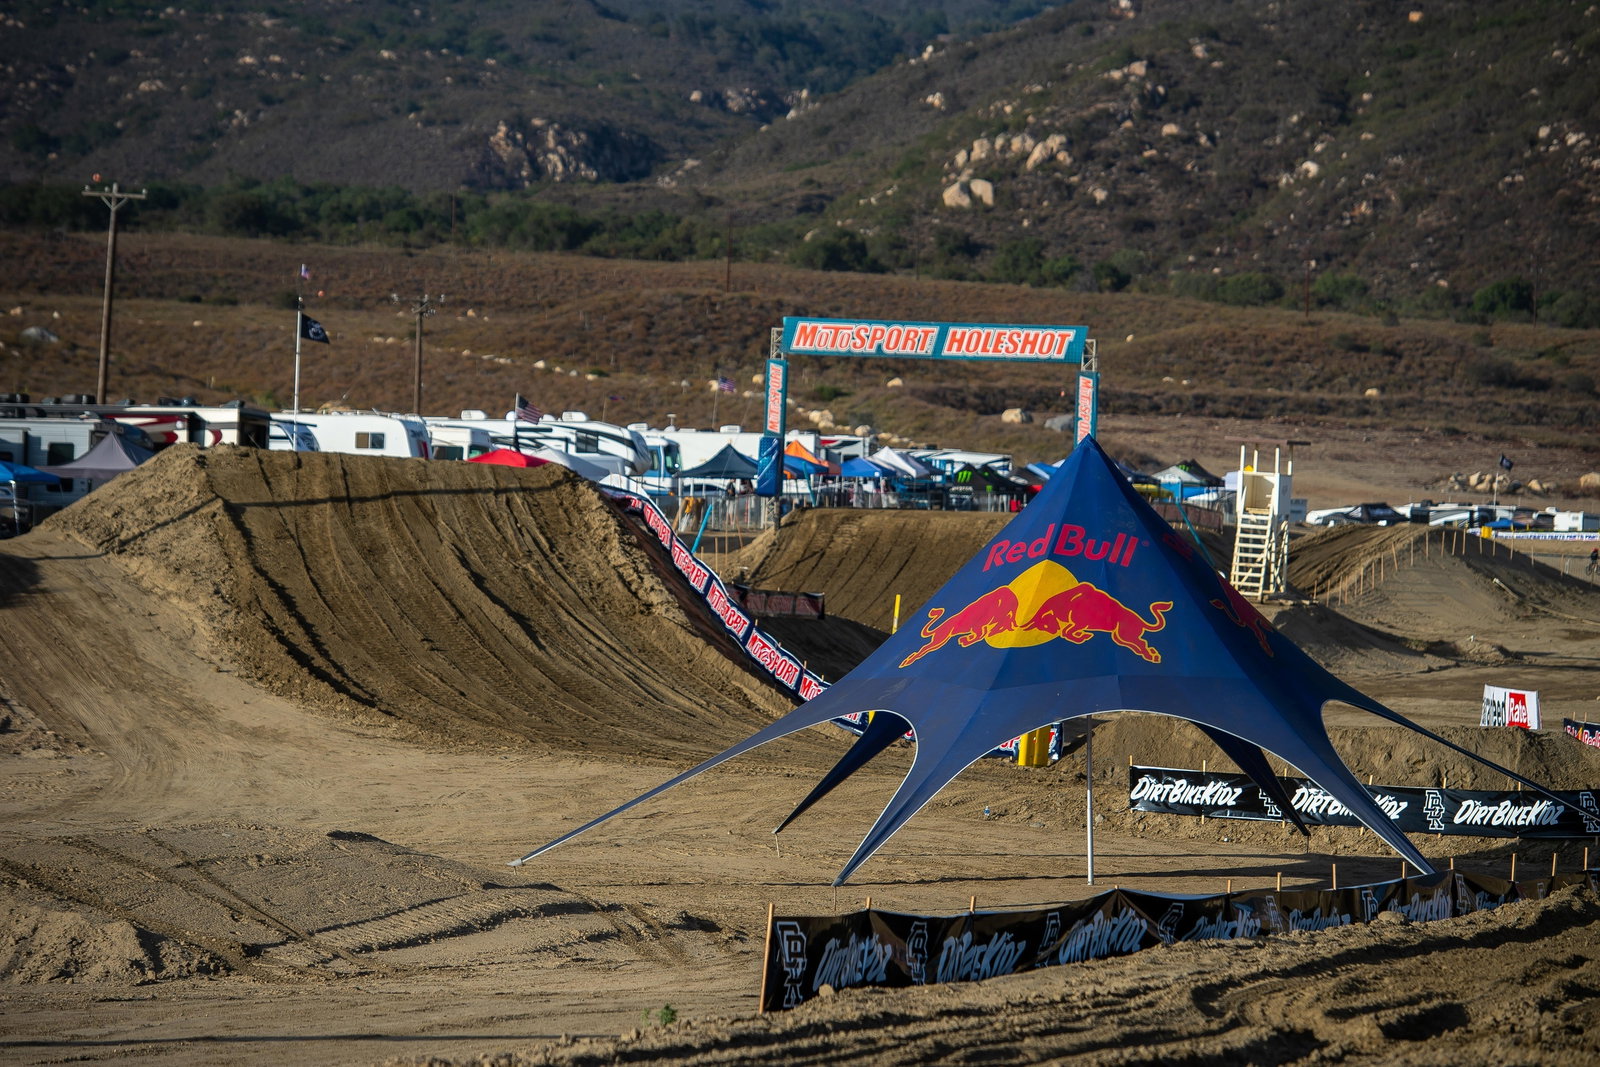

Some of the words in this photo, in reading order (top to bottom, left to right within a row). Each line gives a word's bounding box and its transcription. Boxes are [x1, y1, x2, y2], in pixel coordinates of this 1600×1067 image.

[945, 329, 1073, 355] HOLESHOT
[982, 523, 1056, 572] Red
[1053, 524, 1139, 567] Bull
[1509, 697, 1528, 724] Rate
